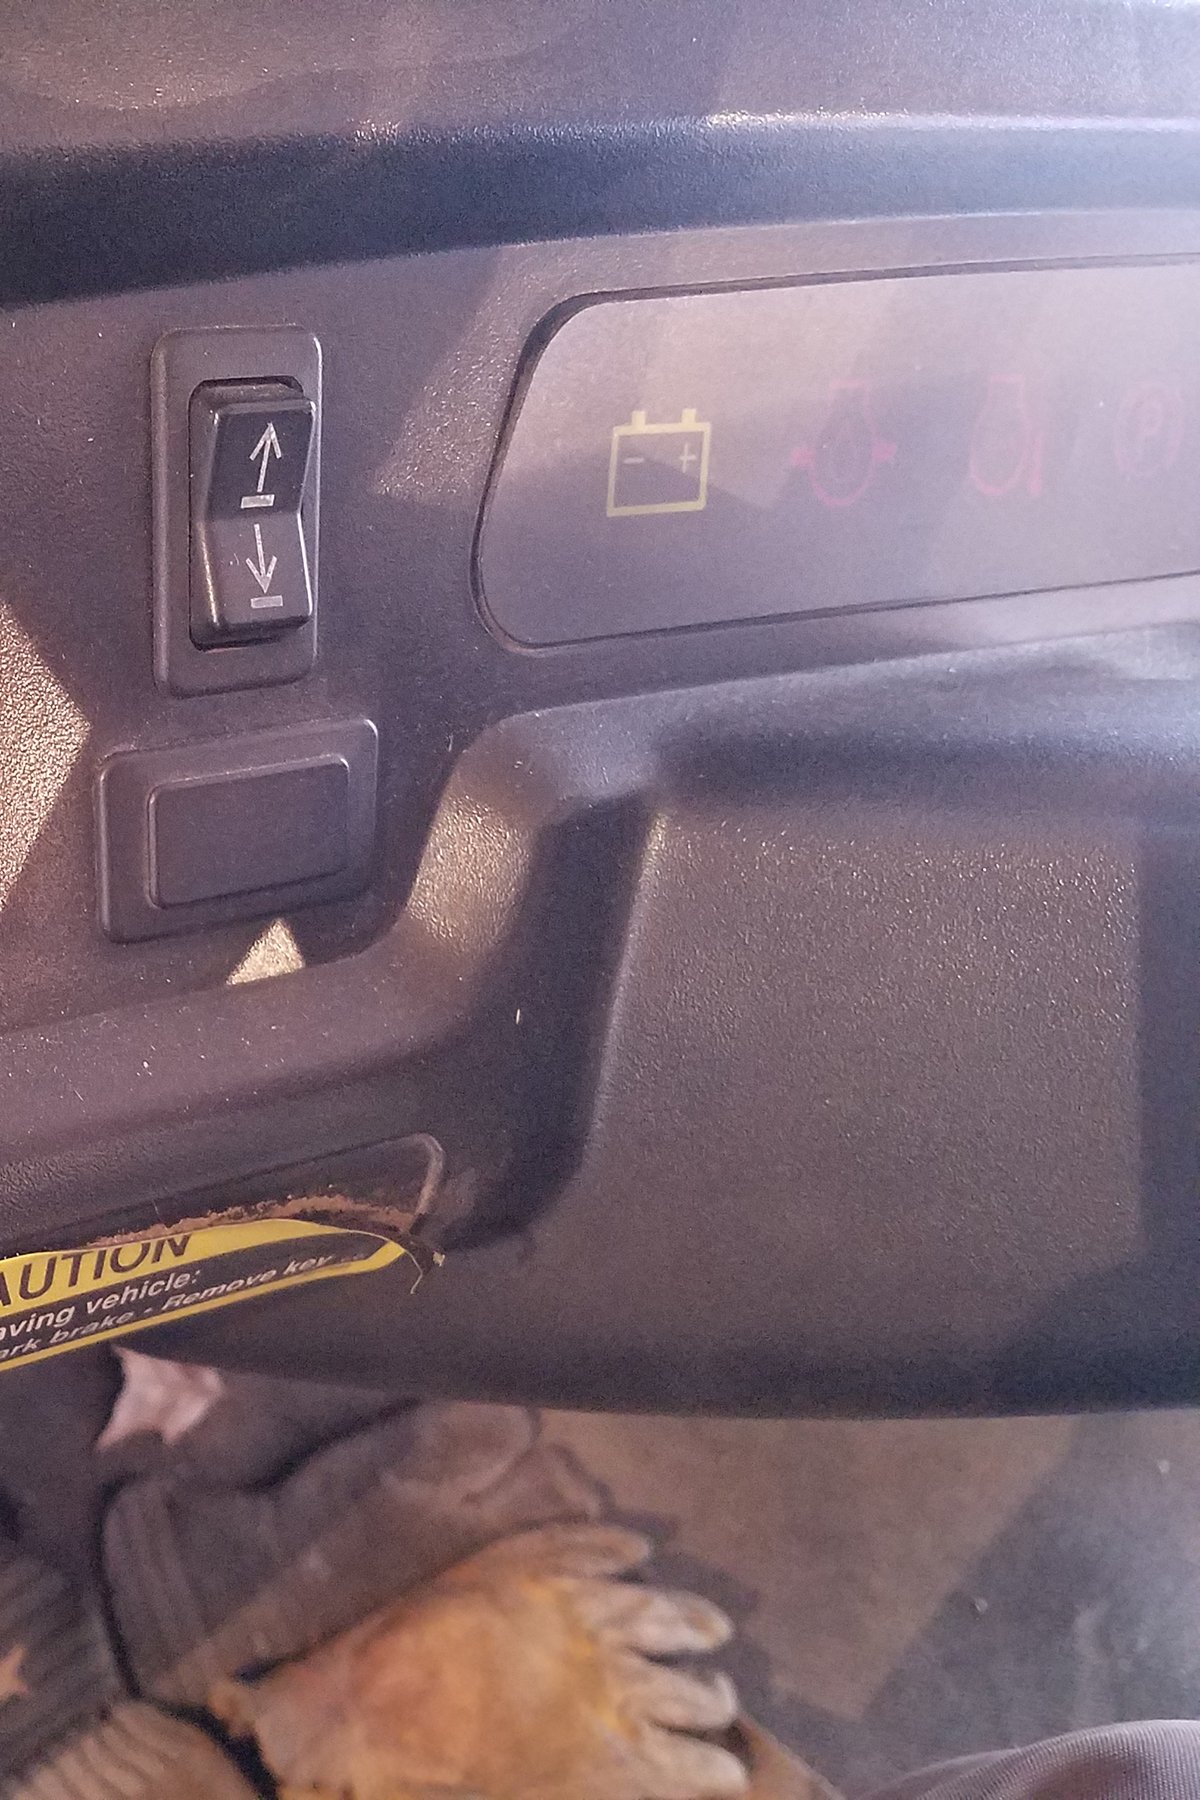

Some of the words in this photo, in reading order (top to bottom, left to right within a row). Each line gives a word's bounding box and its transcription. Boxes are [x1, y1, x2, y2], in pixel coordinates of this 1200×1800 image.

[50, 1308, 135, 1342] brake
[161, 1270, 277, 1311] Remove
[86, 1269, 200, 1314] vehicle:
